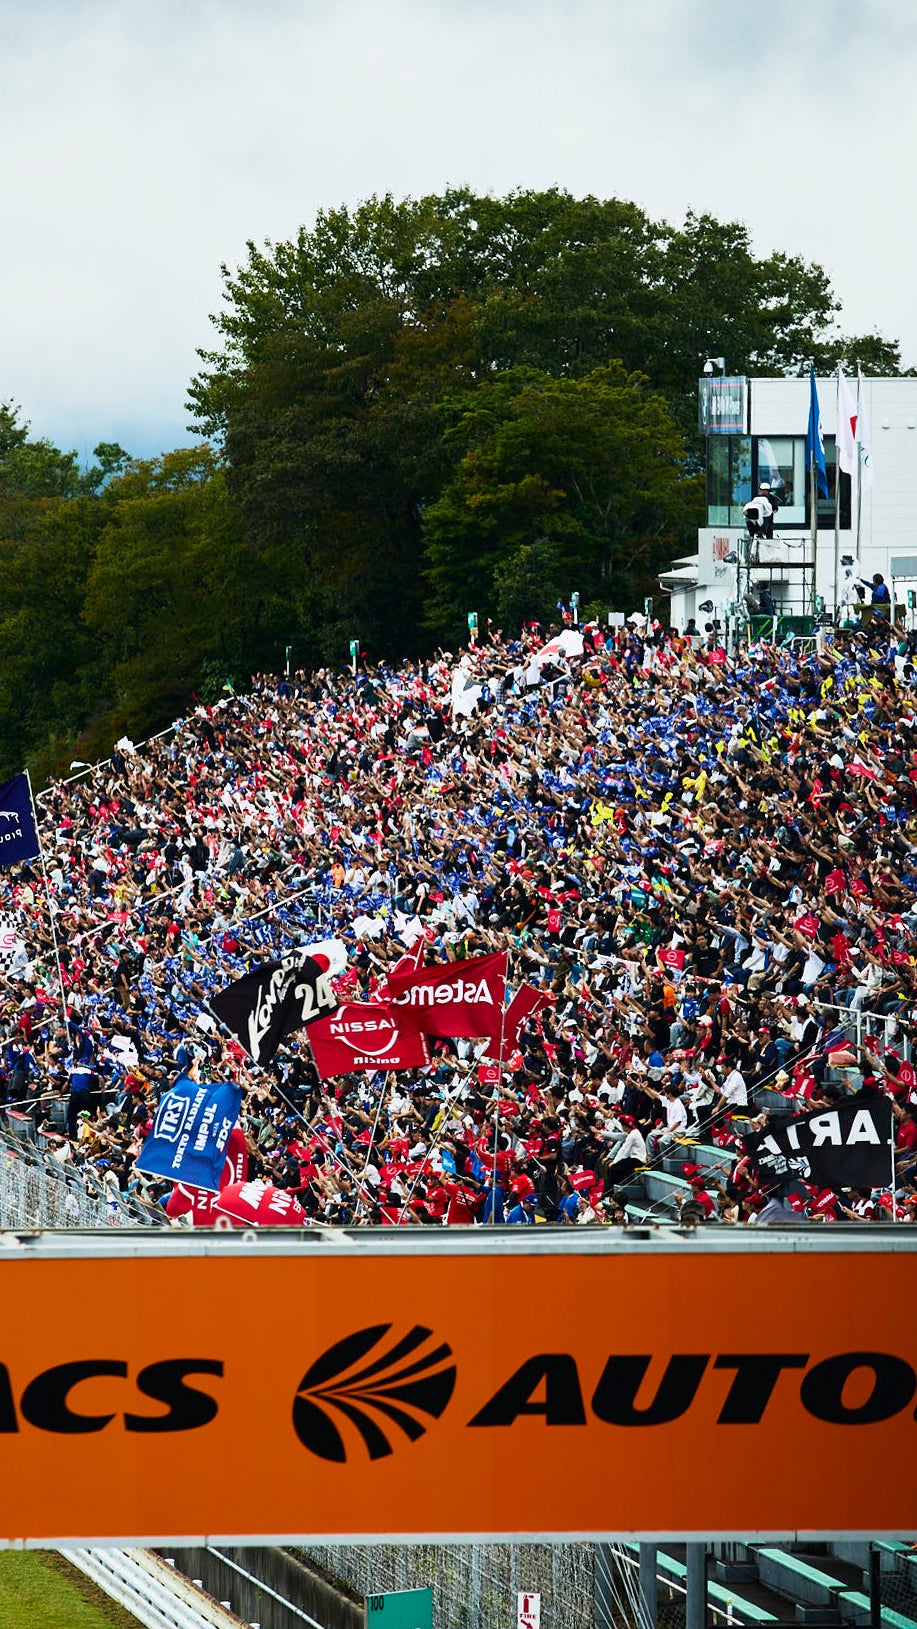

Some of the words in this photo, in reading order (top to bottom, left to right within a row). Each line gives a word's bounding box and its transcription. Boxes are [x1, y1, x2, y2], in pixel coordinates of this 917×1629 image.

[295, 973, 338, 1021] 24
[159, 1098, 184, 1137] TRS
[193, 1103, 218, 1151] IMPUL
[215, 1117, 233, 1151] SDG
[172, 1134, 189, 1168] TOKYO
[0, 1358, 224, 1434] CS
[465, 1351, 917, 1427] AUTO
[370, 1595, 385, 1611] 100
